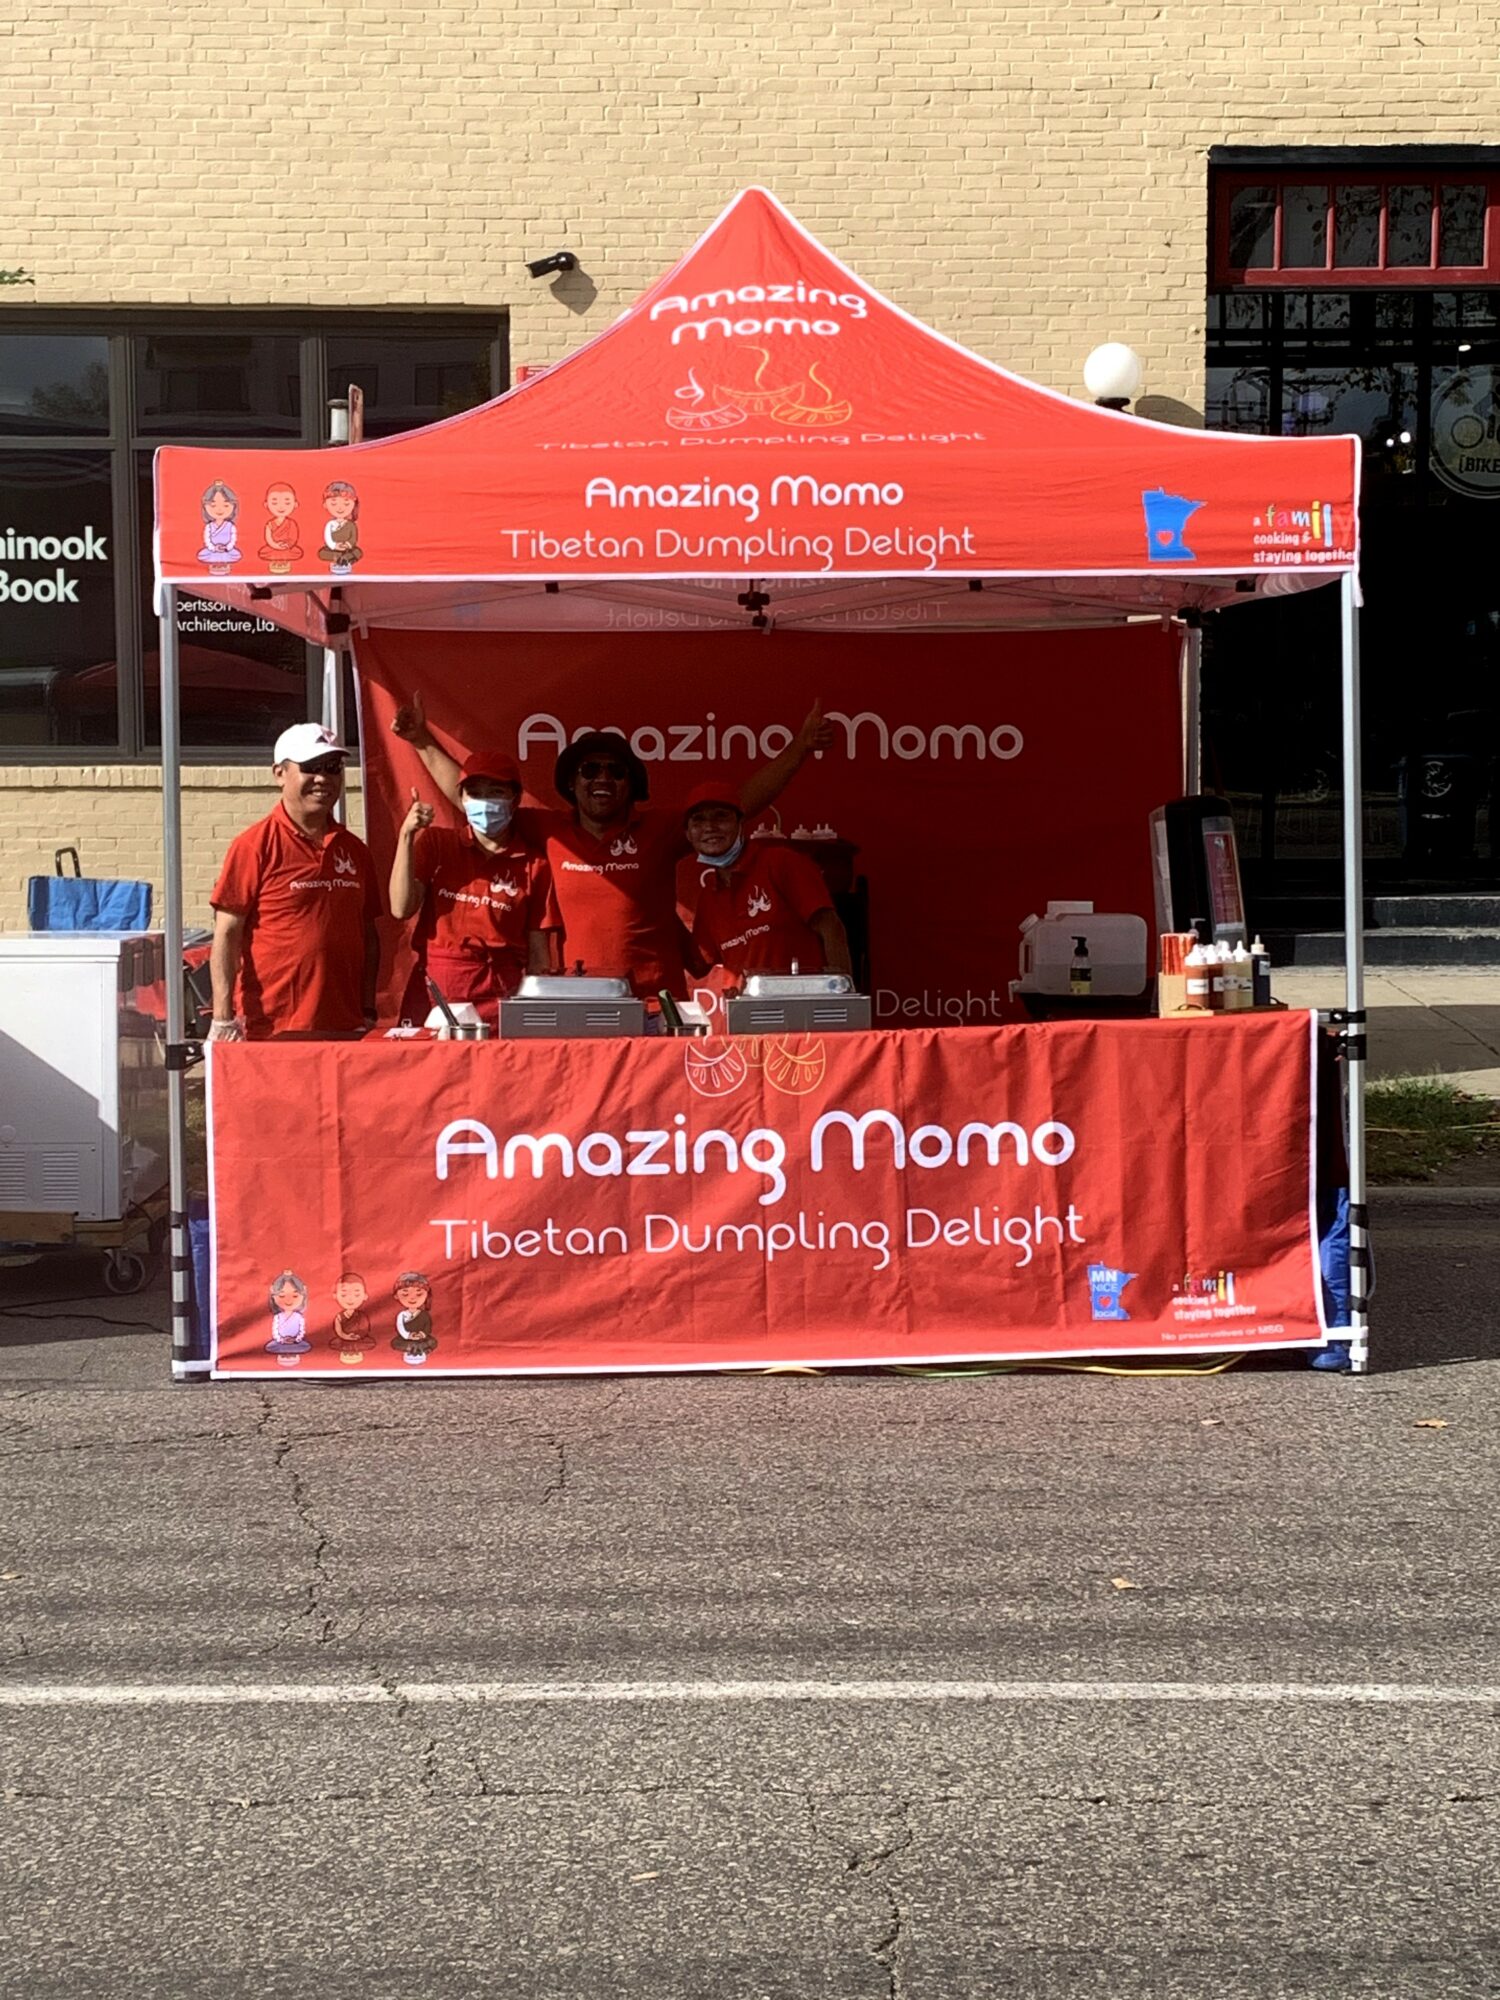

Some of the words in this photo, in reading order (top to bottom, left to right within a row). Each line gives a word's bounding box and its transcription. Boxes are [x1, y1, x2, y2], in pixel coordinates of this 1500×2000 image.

[650, 281, 867, 320] Amazing
[671, 317, 840, 345] Momo
[535, 440, 669, 450] Tibetan
[680, 434, 850, 446] Dumpling
[860, 432, 987, 444] Delight
[585, 476, 760, 523] Amazing
[770, 475, 904, 508] Momo
[0, 526, 108, 561] inook
[500, 529, 644, 559] Tibetan
[655, 528, 834, 572] Dumpling
[845, 527, 977, 571] Delight
[1253, 531, 1300, 547] cooking
[1253, 549, 1302, 565] staying
[561, 861, 604, 876] Amazing
[289, 880, 333, 892] Amazing
[876, 988, 1003, 1027] Delight
[436, 1113, 787, 1206] Amazing
[810, 1109, 1076, 1172] Momo
[430, 1218, 628, 1260] Tibetan
[645, 1211, 890, 1271] Dumpling
[906, 1204, 1087, 1267] Delight
[1092, 1270, 1117, 1282] MN
[1257, 1325, 1285, 1335] MSG
